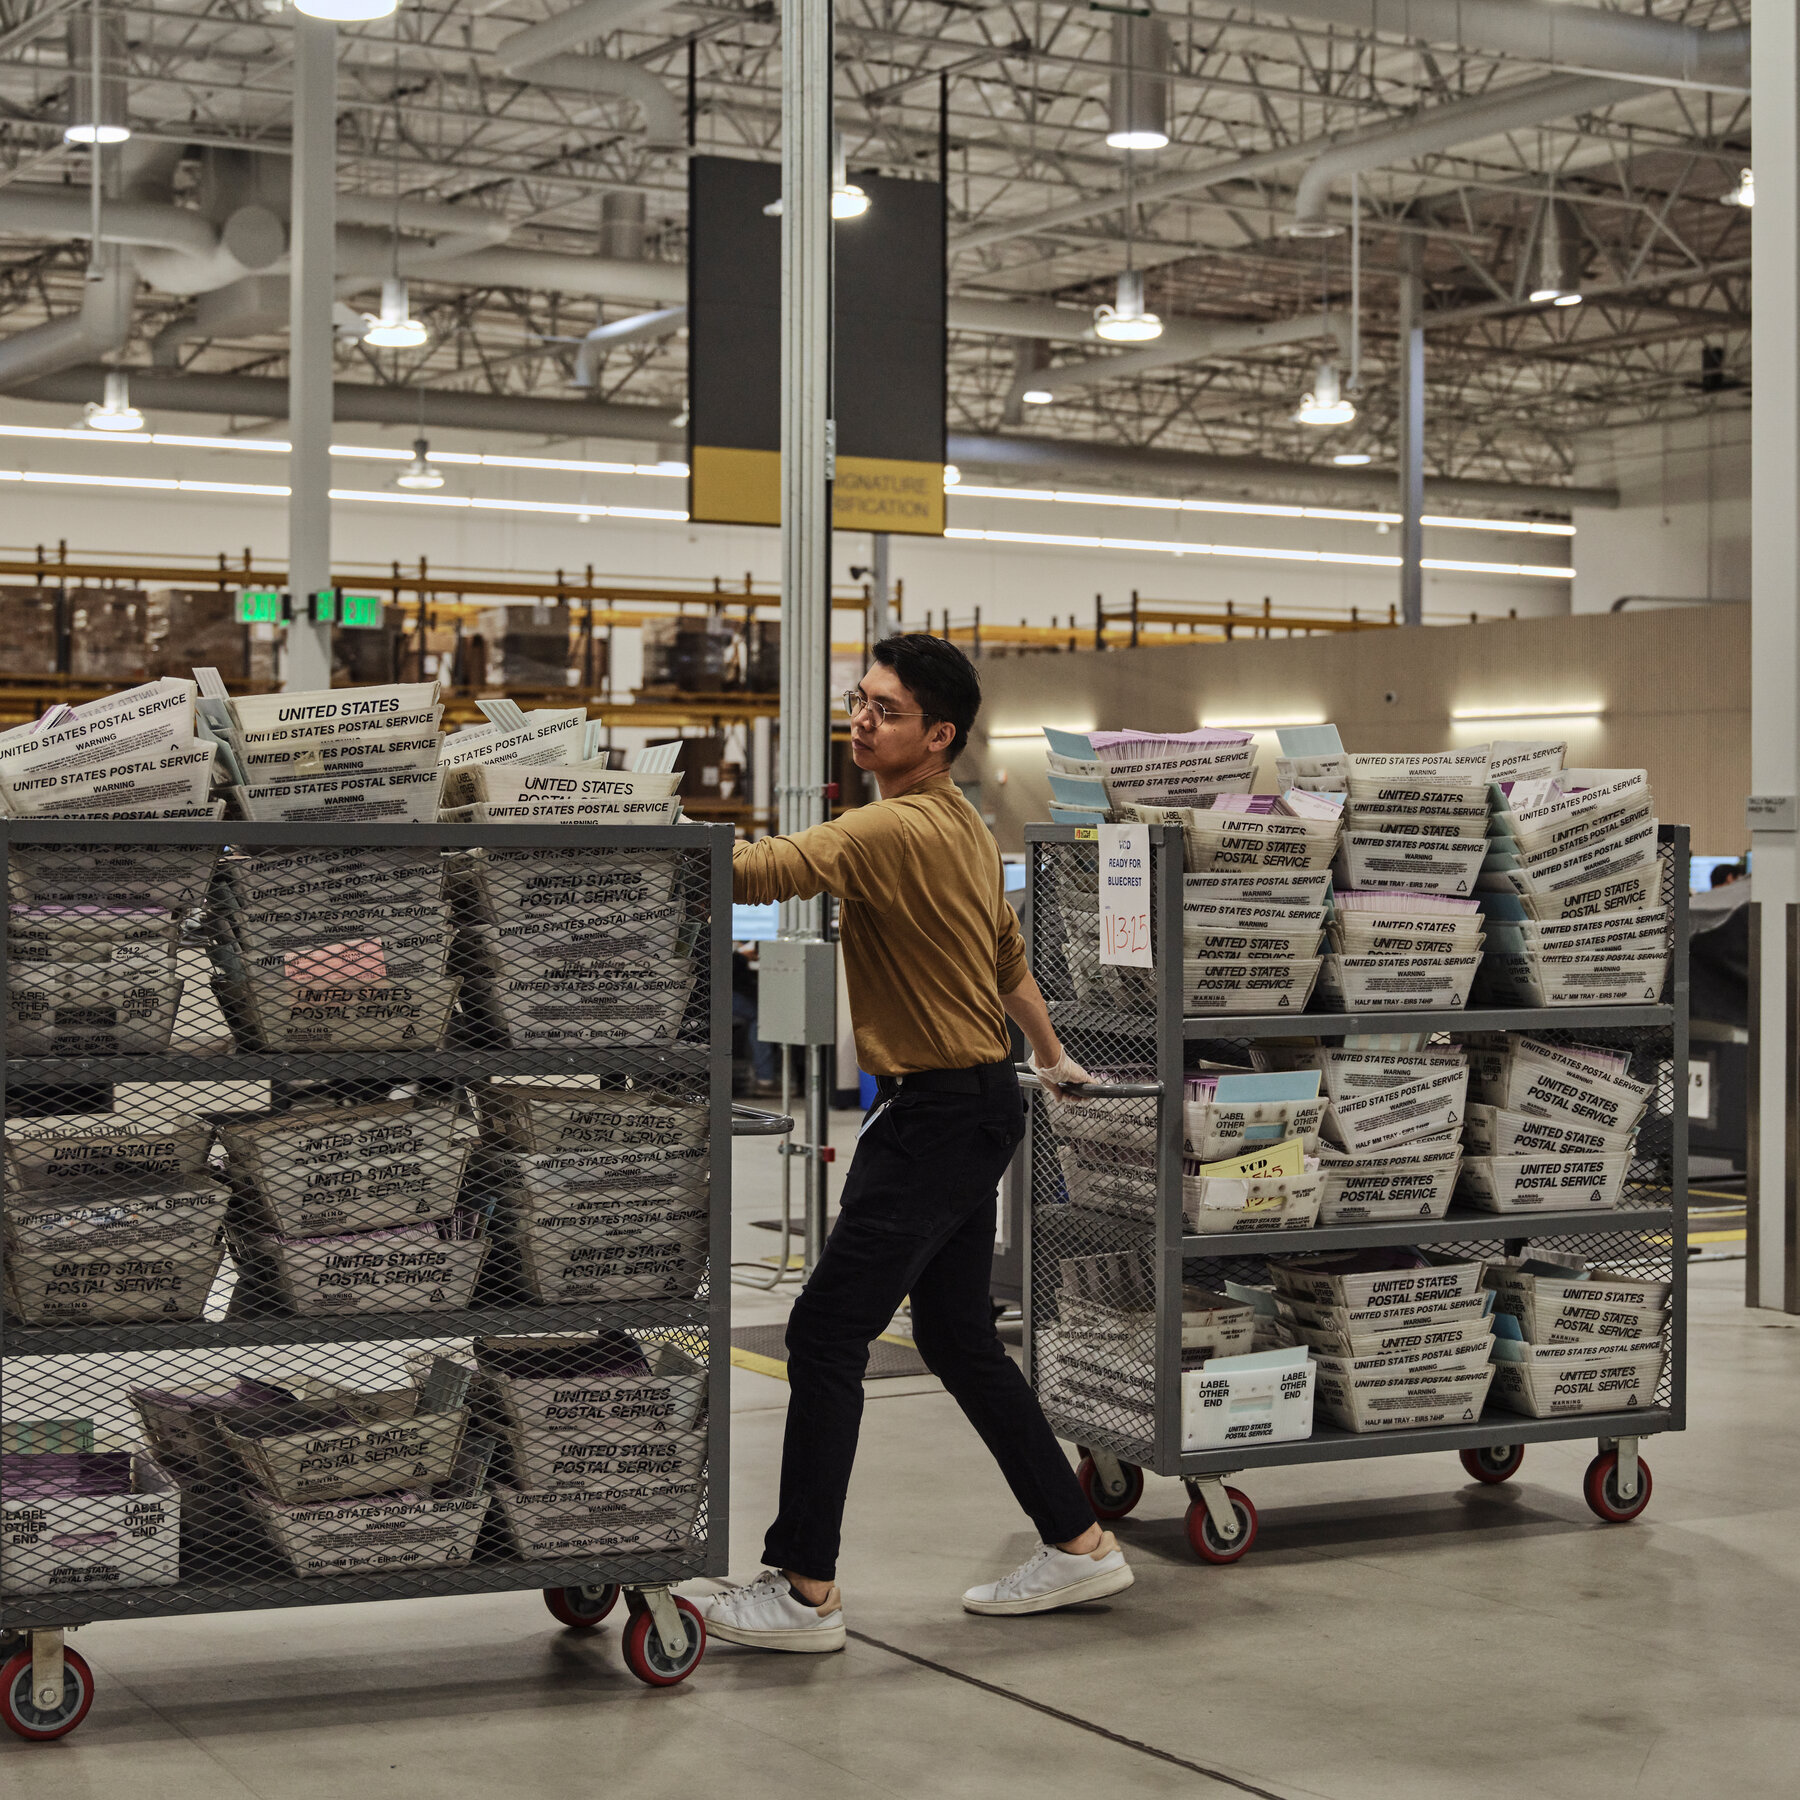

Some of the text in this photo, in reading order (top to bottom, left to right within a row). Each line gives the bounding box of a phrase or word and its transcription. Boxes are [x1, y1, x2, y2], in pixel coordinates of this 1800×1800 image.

[278, 699, 400, 721] UNITED STATES
[43, 727, 87, 747] STATES
[89, 711, 136, 731] POSTAL
[138, 694, 187, 717] SERVICE
[75, 733, 117, 751] WARNING
[1355, 755, 1487, 765] UNITED STATES POSTAL SERVICE
[1502, 745, 1563, 767] POSTAL SERVICE
[1111, 752, 1249, 775] UNITED STATES POSTAL SERVICE
[13, 751, 210, 792] UNITED STATES POSTAL SERVICE
[93, 780, 135, 793] WARNING
[249, 772, 438, 799] UNITED STATES POSTAL SERVICE
[524, 777, 634, 796] UNITED STATES
[1519, 775, 1642, 822] UNITED STATES POSTAL SERVICE
[488, 802, 669, 817] UNITED STATES POSTAL SERVICE
[1571, 804, 1598, 817] WARNING
[1221, 837, 1306, 854] UNITED STATES
[1352, 837, 1484, 852] UNITED STATES POSTAL SERVICE
[1532, 826, 1654, 879] UNITED STATES POSTAL SERVICE
[1109, 859, 1141, 868] READY FOR
[1214, 851, 1311, 868] POSTAL SERVICE
[1108, 877, 1141, 886] BLUECREST
[1186, 876, 1326, 886] UNITED STATES POSTAL SERVICE
[1184, 903, 1322, 919] UNITED STATES POSTAL SERVICE
[1344, 956, 1476, 967] UNITED STATES POSTAL SERVICE
[1204, 967, 1290, 977] UNITED STATES
[1198, 979, 1295, 990] POSTAL SERVICE
[1520, 1039, 1646, 1095] UNITED STATES POSTAL SERVICE
[1566, 1071, 1593, 1084] WARNING
[1219, 1112, 1245, 1120] LABEL
[1296, 1108, 1319, 1119] LABEL
[1216, 1121, 1244, 1129] OTHER
[1293, 1116, 1318, 1126] OTHER
[1219, 1130, 1237, 1138] END
[1297, 1126, 1311, 1134] END
[1240, 1160, 1267, 1173] VCD
[1520, 1161, 1604, 1176] UNITED STATES
[1515, 1175, 1607, 1189] POSTAL SERVICE
[1372, 1275, 1458, 1293] UNITED STATES
[1367, 1288, 1462, 1307] POSTAL SERVICE
[1282, 1371, 1307, 1381] LABEL
[1354, 1372, 1488, 1388] UNITED STATES POSTAL SERVICE
[1560, 1367, 1636, 1381] UNITED STATES
[1201, 1380, 1230, 1388] LABEL
[1280, 1380, 1306, 1390] OTHER
[1554, 1378, 1640, 1395] POSTAL SERVICE
[1199, 1389, 1229, 1398] OTHER
[1284, 1390, 1300, 1399] END
[1407, 1388, 1437, 1396] WARNING
[1204, 1399, 1222, 1407] END
[1224, 1428, 1273, 1440] POSTAL SERVICE
[1228, 1422, 1272, 1434] UNITED STATES
[125, 1503, 164, 1514] LABEL
[6, 1510, 46, 1520] LABEL
[124, 1514, 165, 1526] OTHER
[5, 1522, 47, 1532] OTHER
[132, 1527, 157, 1537] END
[13, 1535, 39, 1544] END
